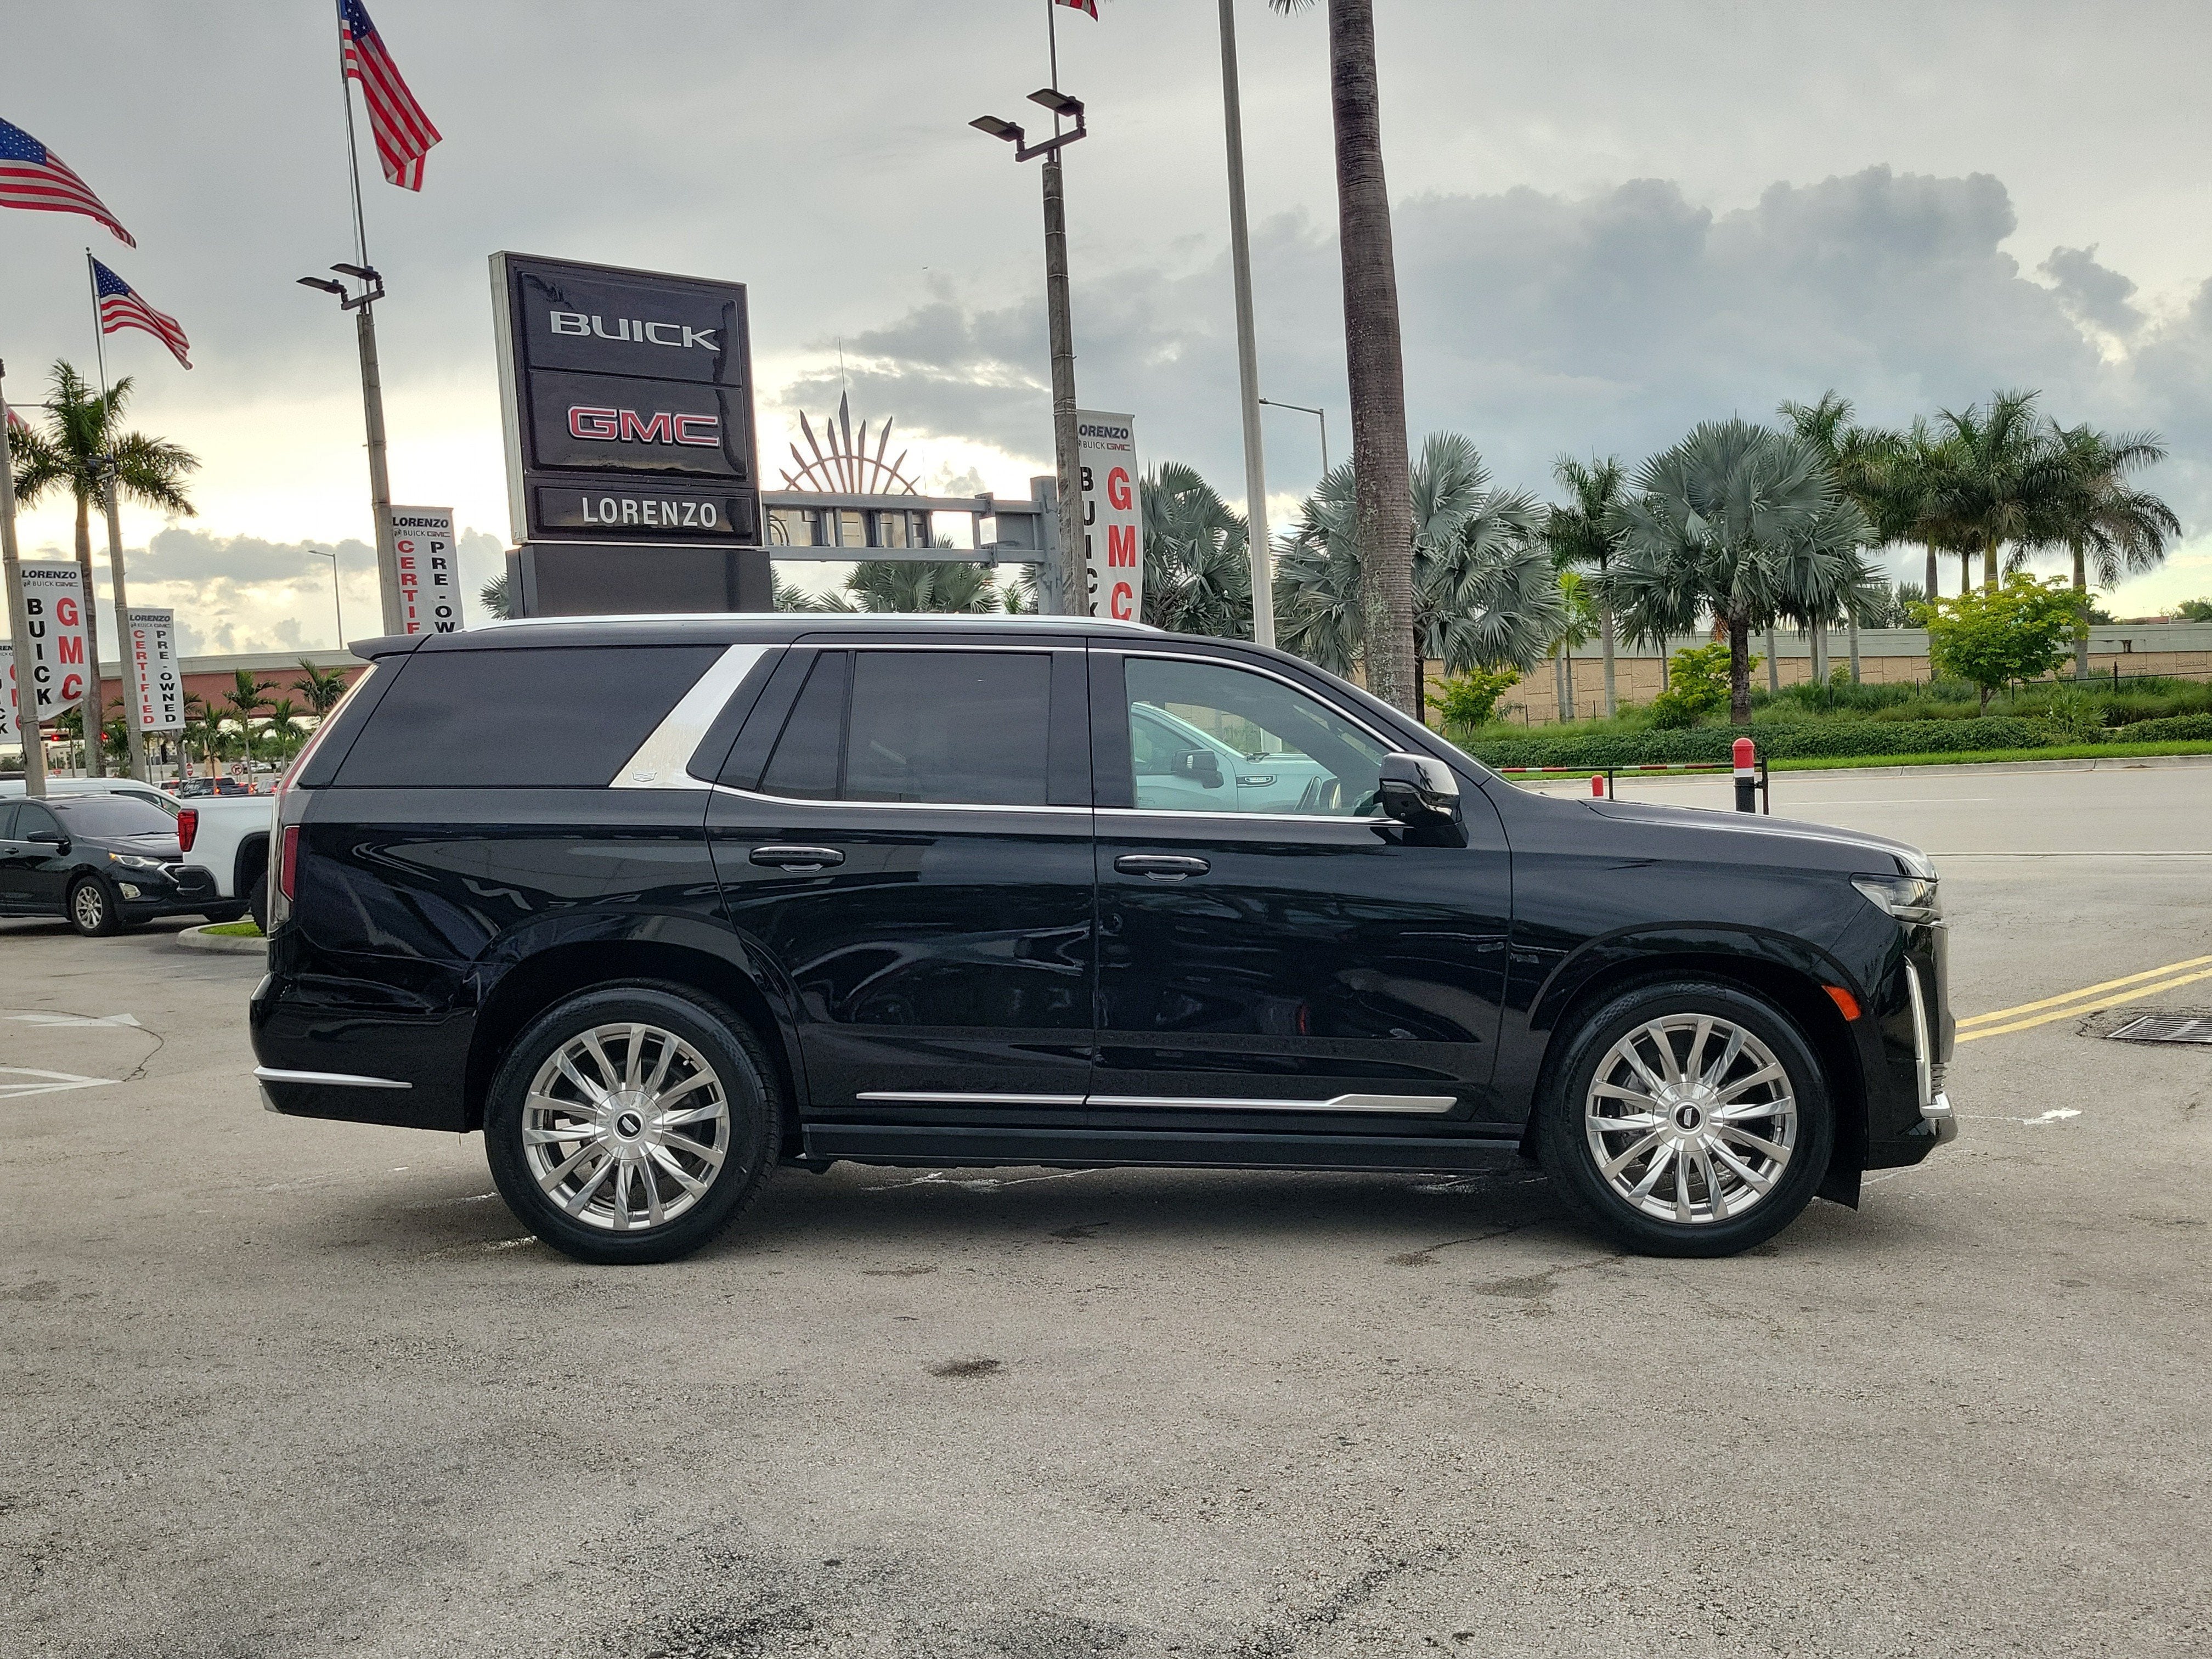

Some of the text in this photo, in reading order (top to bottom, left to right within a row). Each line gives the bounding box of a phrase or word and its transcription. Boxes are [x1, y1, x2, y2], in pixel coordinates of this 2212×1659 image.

[550, 311, 721, 351] BUICK
[567, 405, 720, 447] GMC
[1078, 425, 1128, 439] ORENZO
[1083, 441, 1131, 451] BUICK GMC
[392, 517, 449, 528] LORENZO
[582, 497, 717, 528] LORENZO
[1108, 466, 1136, 620] GMC
[21, 570, 77, 579] LORENZO
[398, 540, 421, 634] CERTIF
[431, 541, 455, 633] PRE-OW
[27, 598, 52, 706] BUICK
[57, 597, 84, 700] GMC
[133, 630, 154, 724] CERTIFIED
[156, 630, 176, 723] PRE-OWNED
